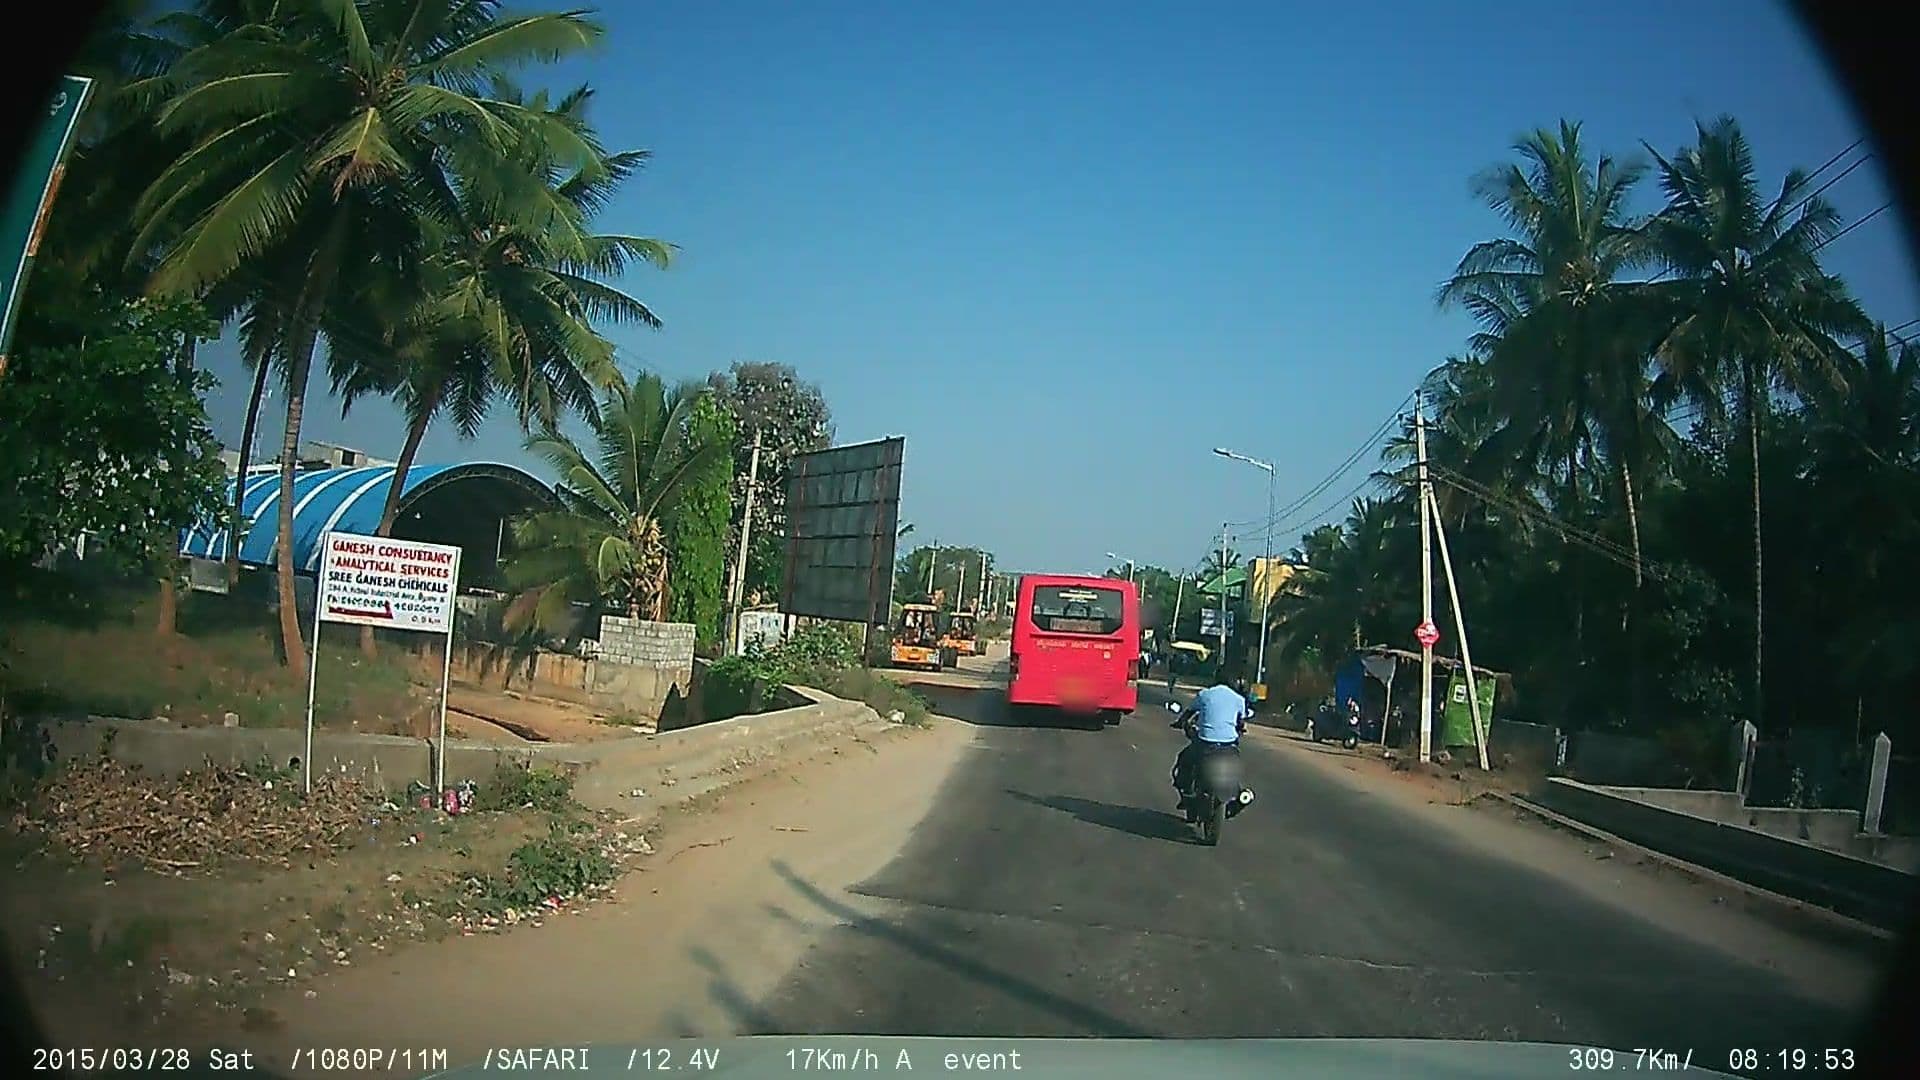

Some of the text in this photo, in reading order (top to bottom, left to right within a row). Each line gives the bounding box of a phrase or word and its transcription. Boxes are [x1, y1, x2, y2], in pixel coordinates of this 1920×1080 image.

[333, 540, 453, 565] GANESH CONSULTANCY
[335, 556, 396, 573] ANALYTICAL
[400, 564, 449, 578] SERVICES
[329, 571, 449, 593] SREE GANESH CHEMICALS
